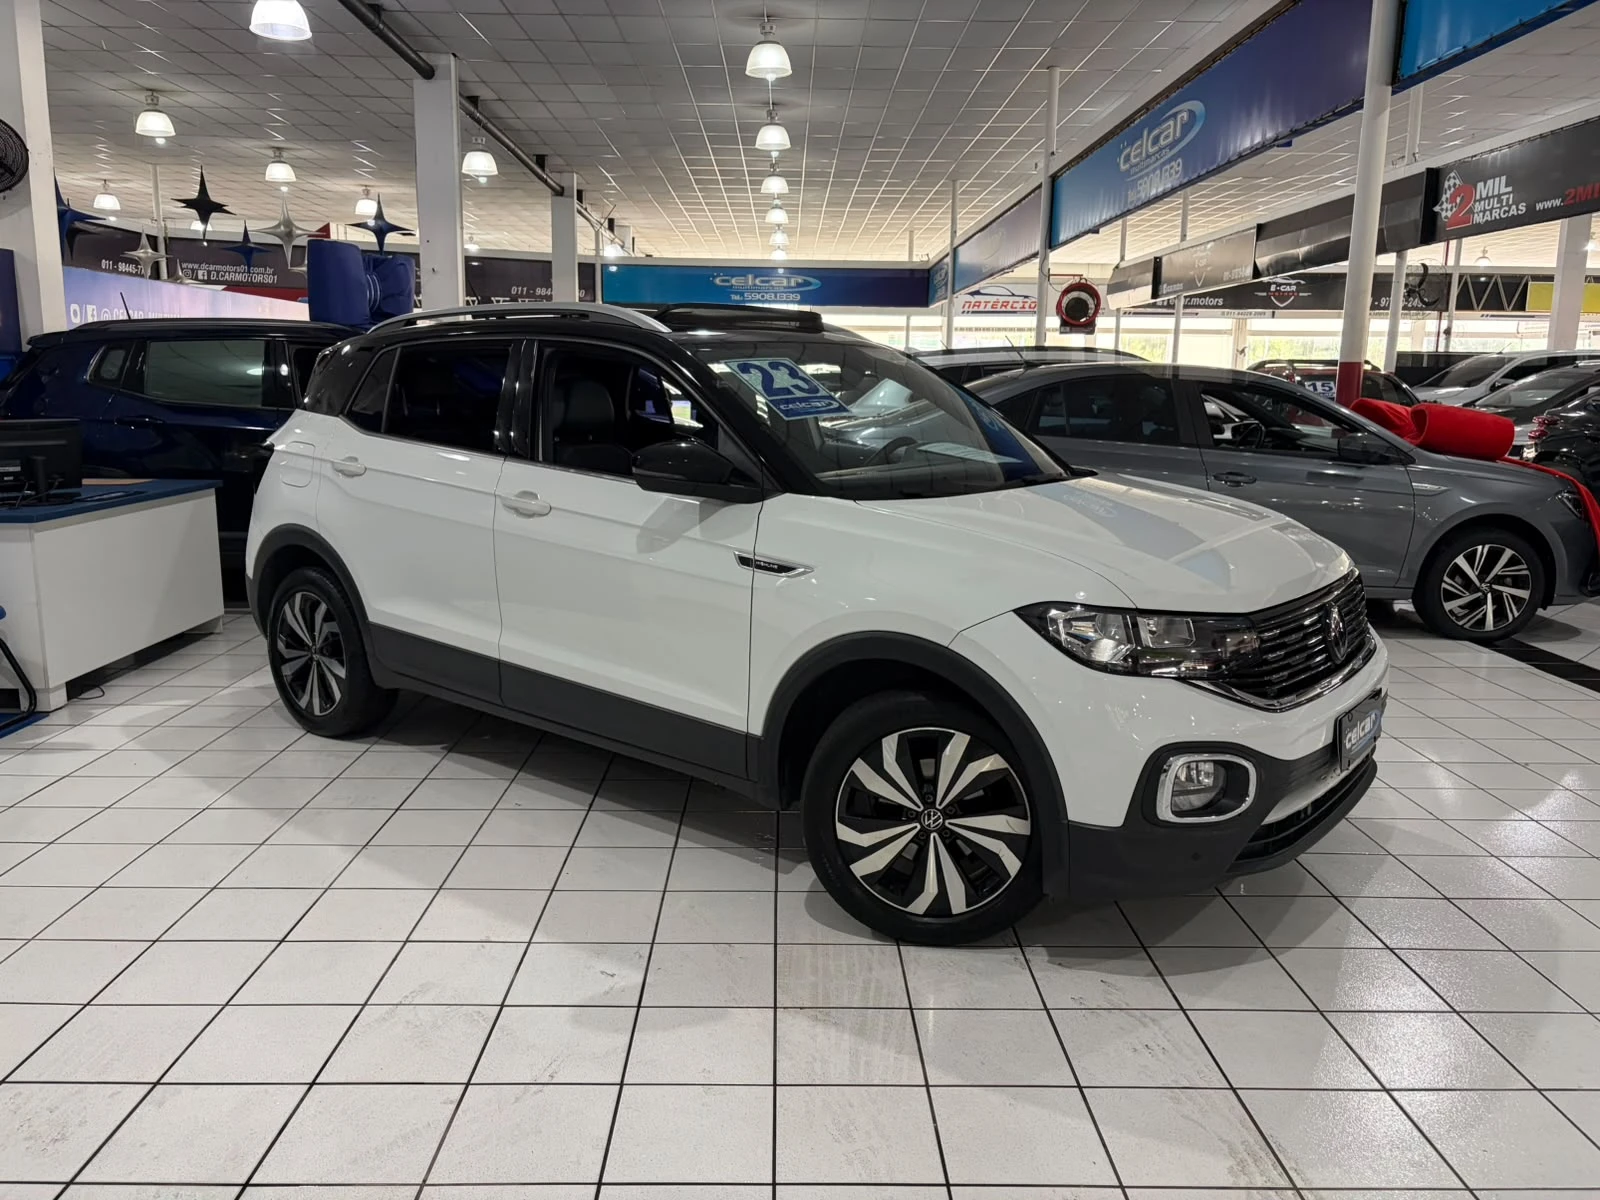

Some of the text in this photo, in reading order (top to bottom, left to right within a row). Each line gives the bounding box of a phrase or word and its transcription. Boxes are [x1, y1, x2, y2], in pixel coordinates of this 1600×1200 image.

[1119, 109, 1190, 173] celcar
[1475, 175, 1513, 200] MIL
[1446, 183, 1476, 231] 2
[1474, 193, 1514, 213] MULTI
[1473, 202, 1527, 225] MARCAS
[101, 259, 114, 270] 011
[181, 262, 275, 274] www.dcarmotors01com.br
[713, 273, 804, 287] celcar
[511, 285, 527, 296] 011
[744, 292, 801, 301] 5908.1339
[737, 361, 820, 397] 23
[1307, 382, 1334, 393] 15
[1345, 711, 1377, 750] celcar
